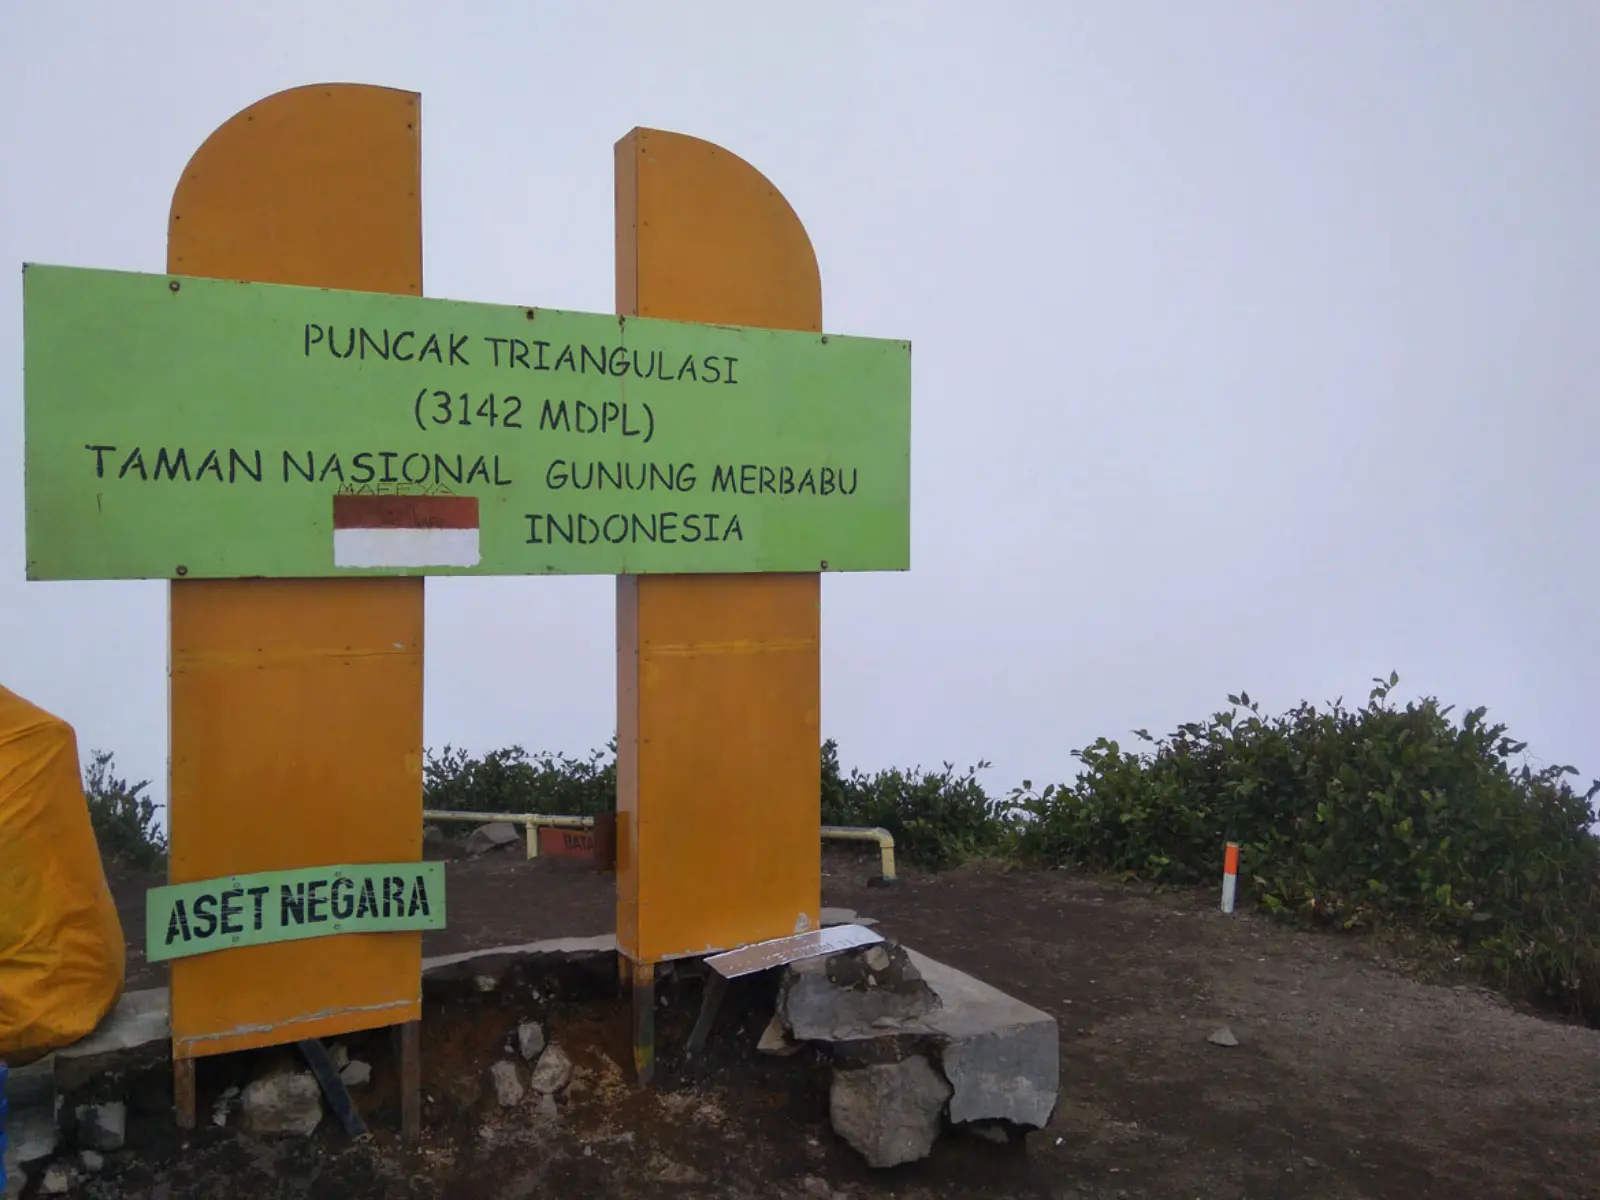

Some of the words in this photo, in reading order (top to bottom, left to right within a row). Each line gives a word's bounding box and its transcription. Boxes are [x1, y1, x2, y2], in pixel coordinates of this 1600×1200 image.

[304, 323, 470, 366] PUNCAK
[483, 337, 738, 384] TRIANGULASI
[415, 388, 522, 431] (3142
[539, 399, 654, 443] MDPL)
[85, 444, 262, 484] TAMAN
[282, 450, 512, 485] NASIONAL
[546, 459, 697, 492] GUNUNG
[711, 464, 857, 496] MERBABU
[524, 511, 743, 545] INDONESIA
[165, 885, 271, 945] ASET
[280, 875, 431, 927] NEGARA
